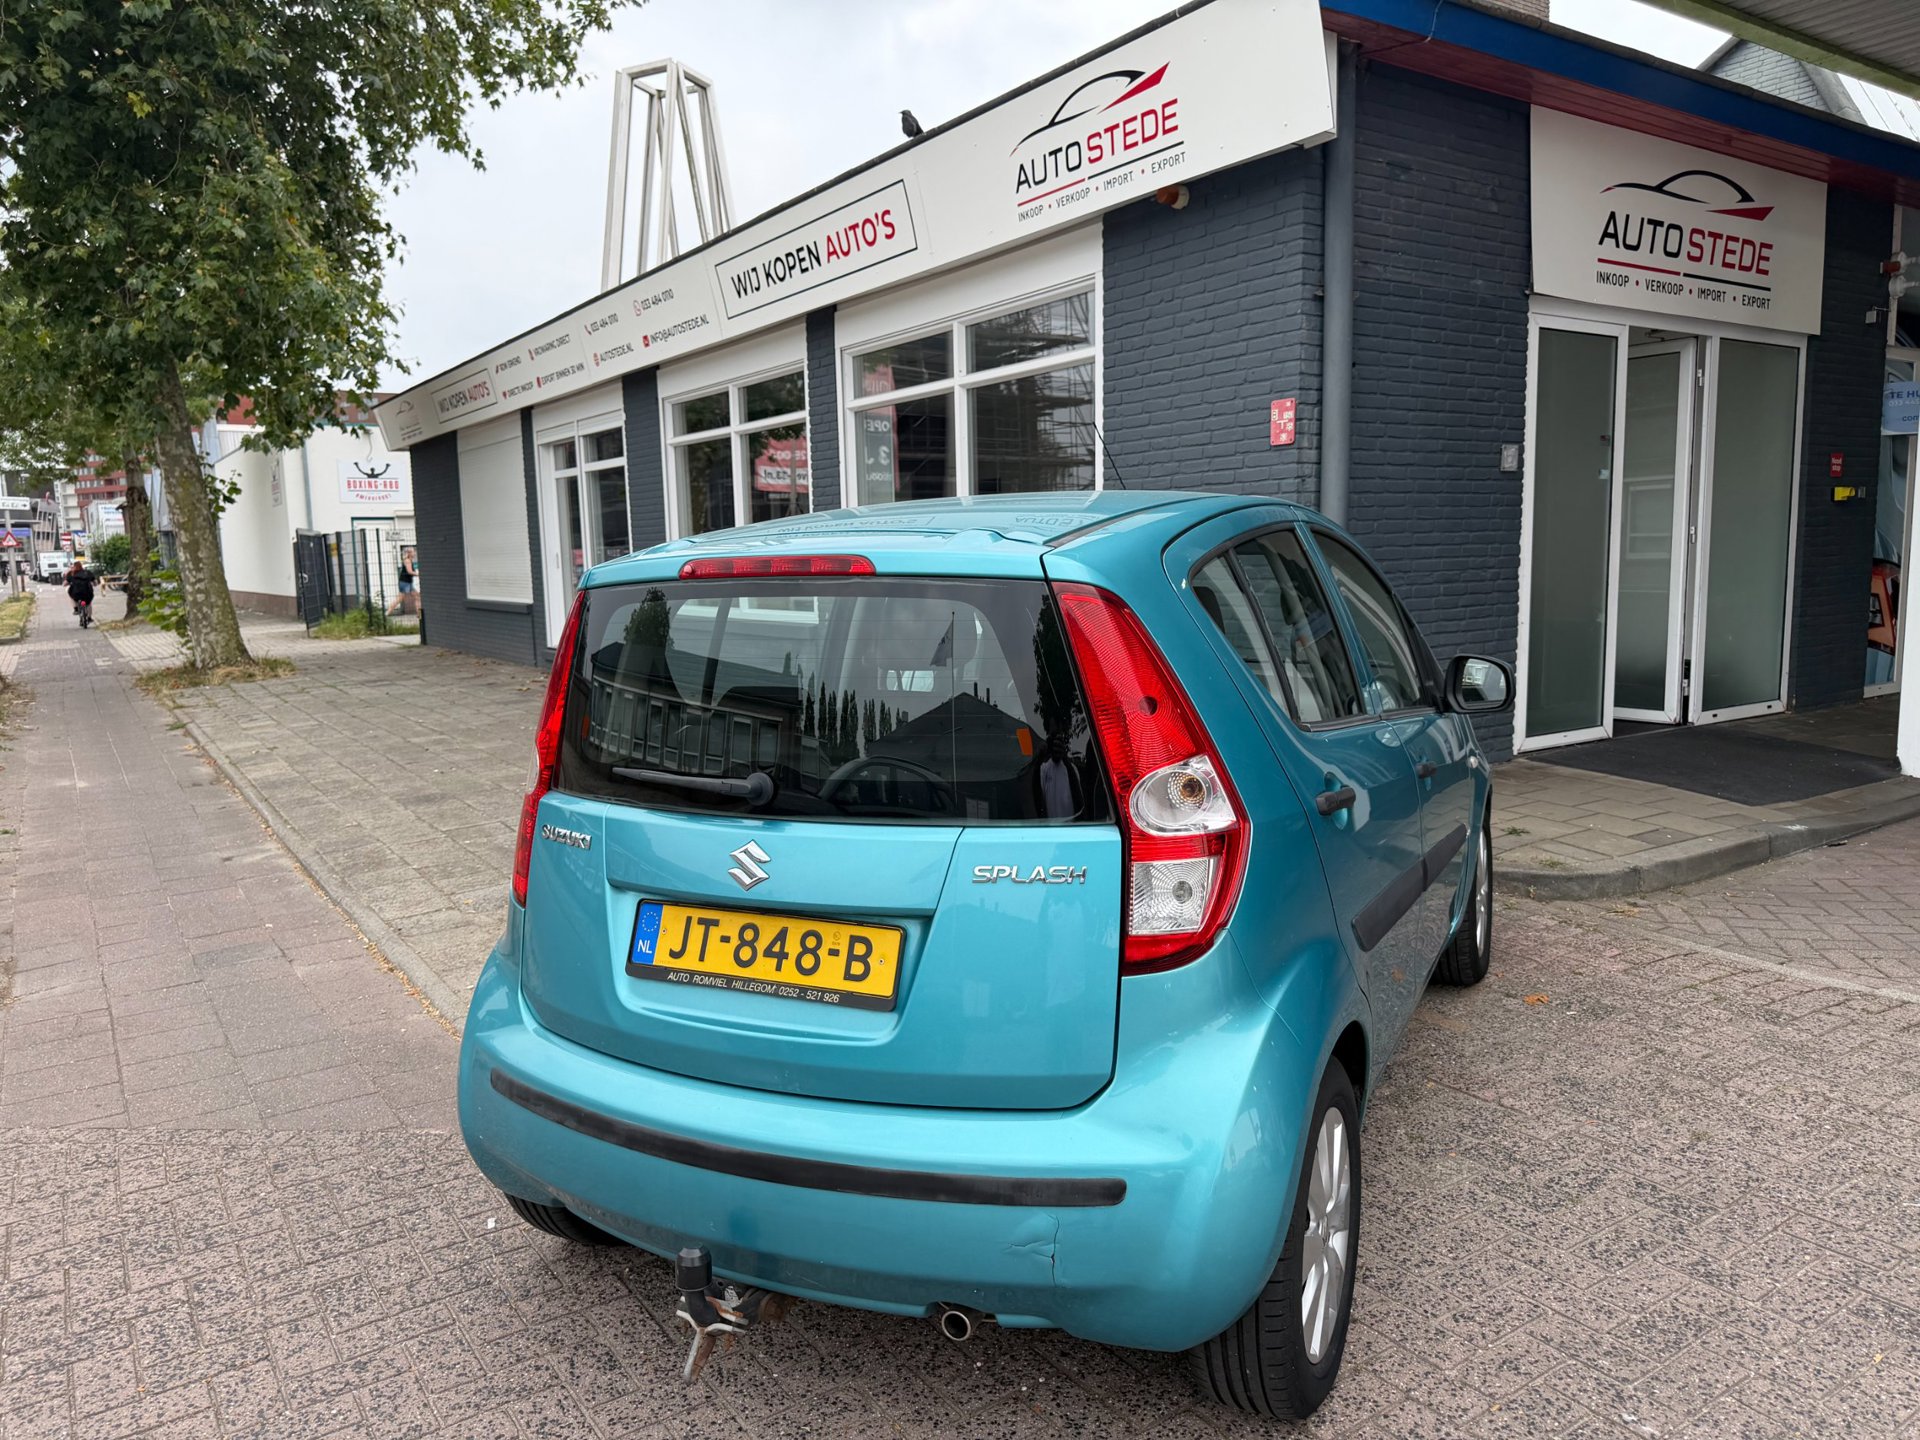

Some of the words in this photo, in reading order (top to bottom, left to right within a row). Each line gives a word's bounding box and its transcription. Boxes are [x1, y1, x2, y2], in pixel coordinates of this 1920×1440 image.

[1018, 204, 1044, 223] INKOOP
[1055, 187, 1090, 208] VERKOOP
[1103, 171, 1133, 191] IMPORT
[1151, 152, 1186, 174] EXPORT
[731, 267, 760, 299] WIJ
[762, 241, 822, 287] KOPEN
[825, 209, 896, 263] AUTO'S
[1596, 270, 1630, 288] INKOOP
[1645, 279, 1684, 296] VERKOOP
[1697, 287, 1726, 303] IMPORT
[1742, 294, 1771, 310] EXPORT
[650, 314, 709, 344] INFO@AUTOSTEDE.NL
[600, 342, 634, 362] AUTOSTEDE.NL
[449, 391, 469, 410] KOPEN
[542, 824, 592, 851] SUZUKI
[972, 865, 1087, 884] SPLASH
[637, 939, 653, 954] NL
[669, 915, 874, 982] JT-848-B
[667, 971, 690, 983] AUTO
[692, 975, 728, 988] ROMVIEL
[778, 986, 799, 998] 0252
[806, 990, 822, 1000] 521
[823, 993, 840, 1003] 926
